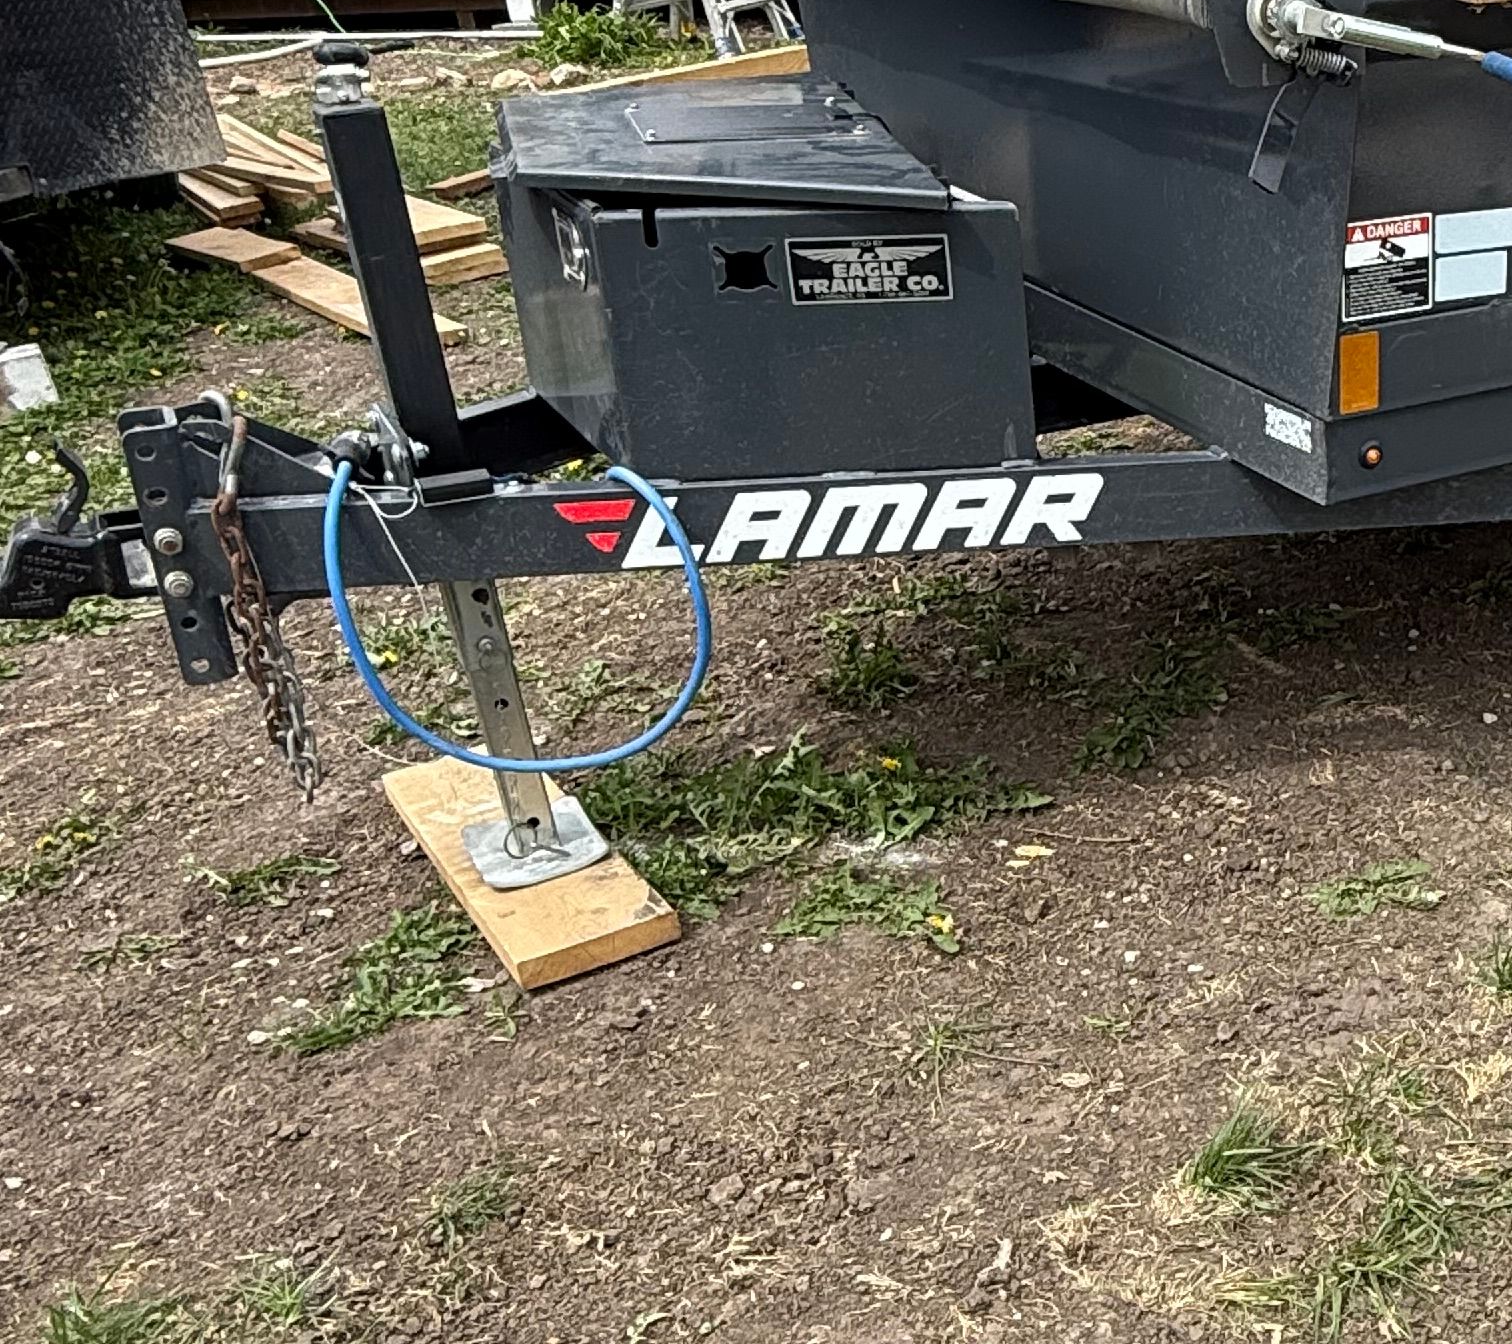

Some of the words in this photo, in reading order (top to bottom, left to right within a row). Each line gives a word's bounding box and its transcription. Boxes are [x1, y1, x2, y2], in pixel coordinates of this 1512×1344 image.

[1366, 219, 1422, 238] DANGER
[832, 261, 908, 278] EAGLE
[798, 276, 900, 294] TRAILER
[906, 274, 944, 291] CO.
[621, 472, 1104, 569] LAMAR
